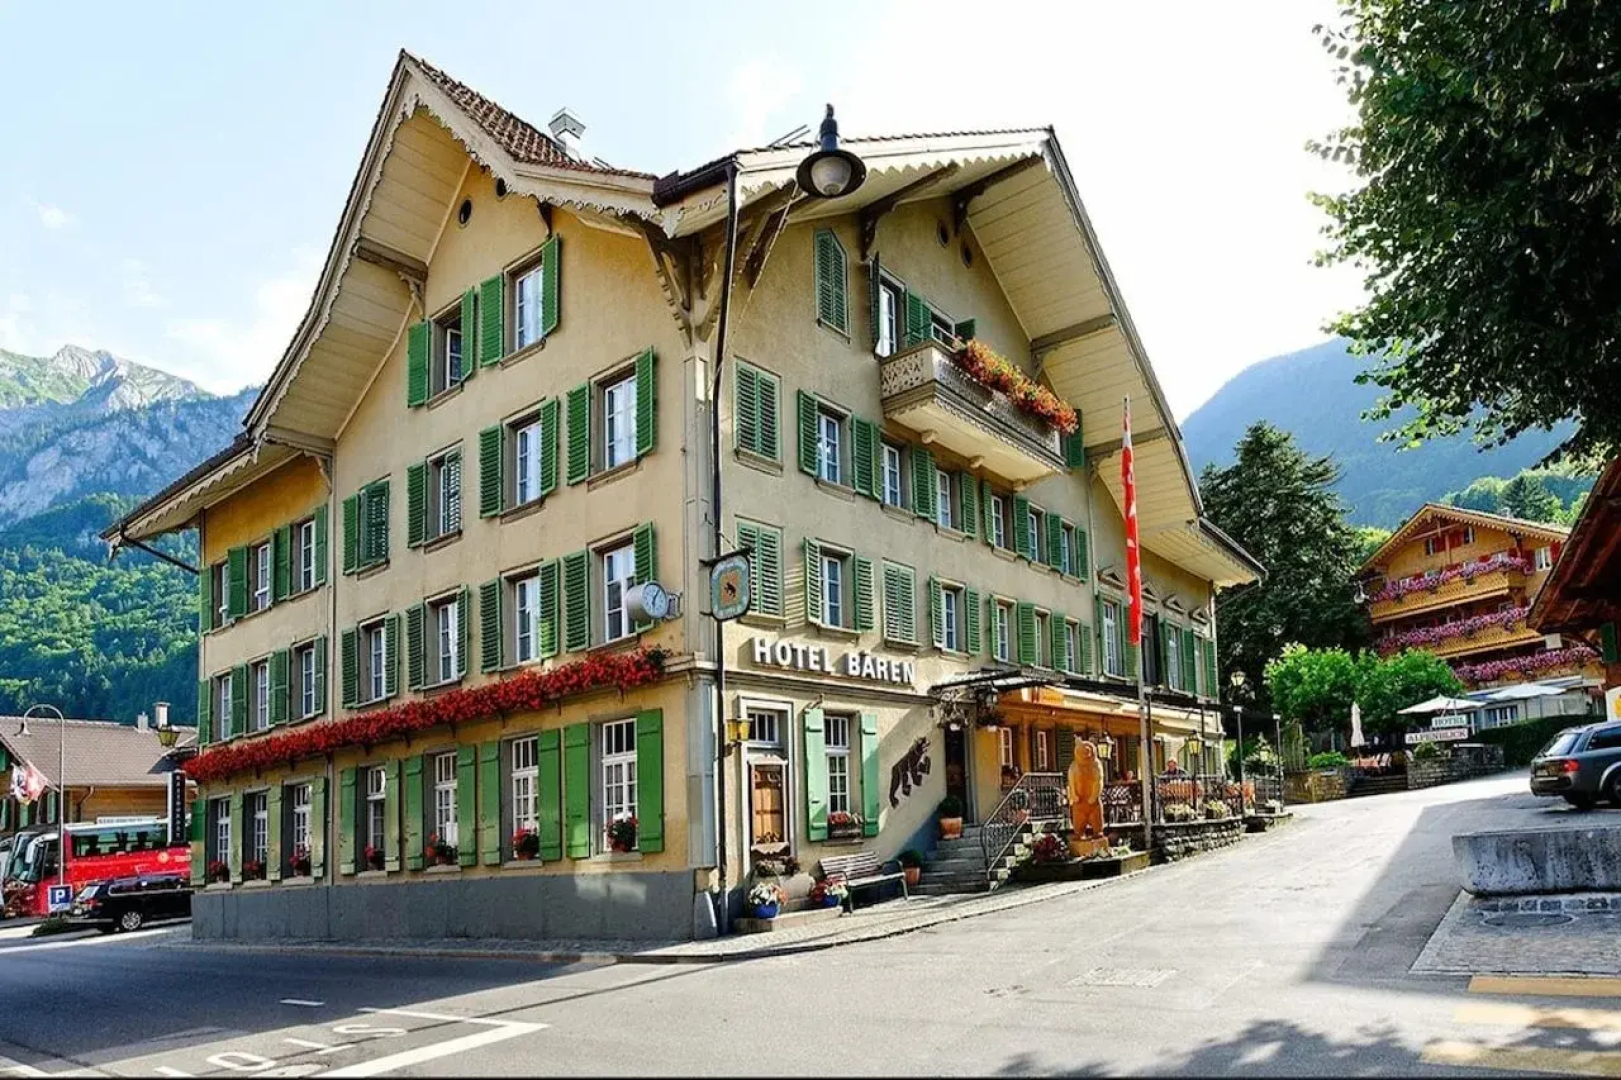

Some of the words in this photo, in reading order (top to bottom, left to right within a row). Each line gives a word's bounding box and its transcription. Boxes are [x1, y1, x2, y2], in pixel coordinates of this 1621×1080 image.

[754, 637, 835, 672] HOTEL
[848, 648, 916, 683] BÄREN
[56, 889, 66, 902] P
